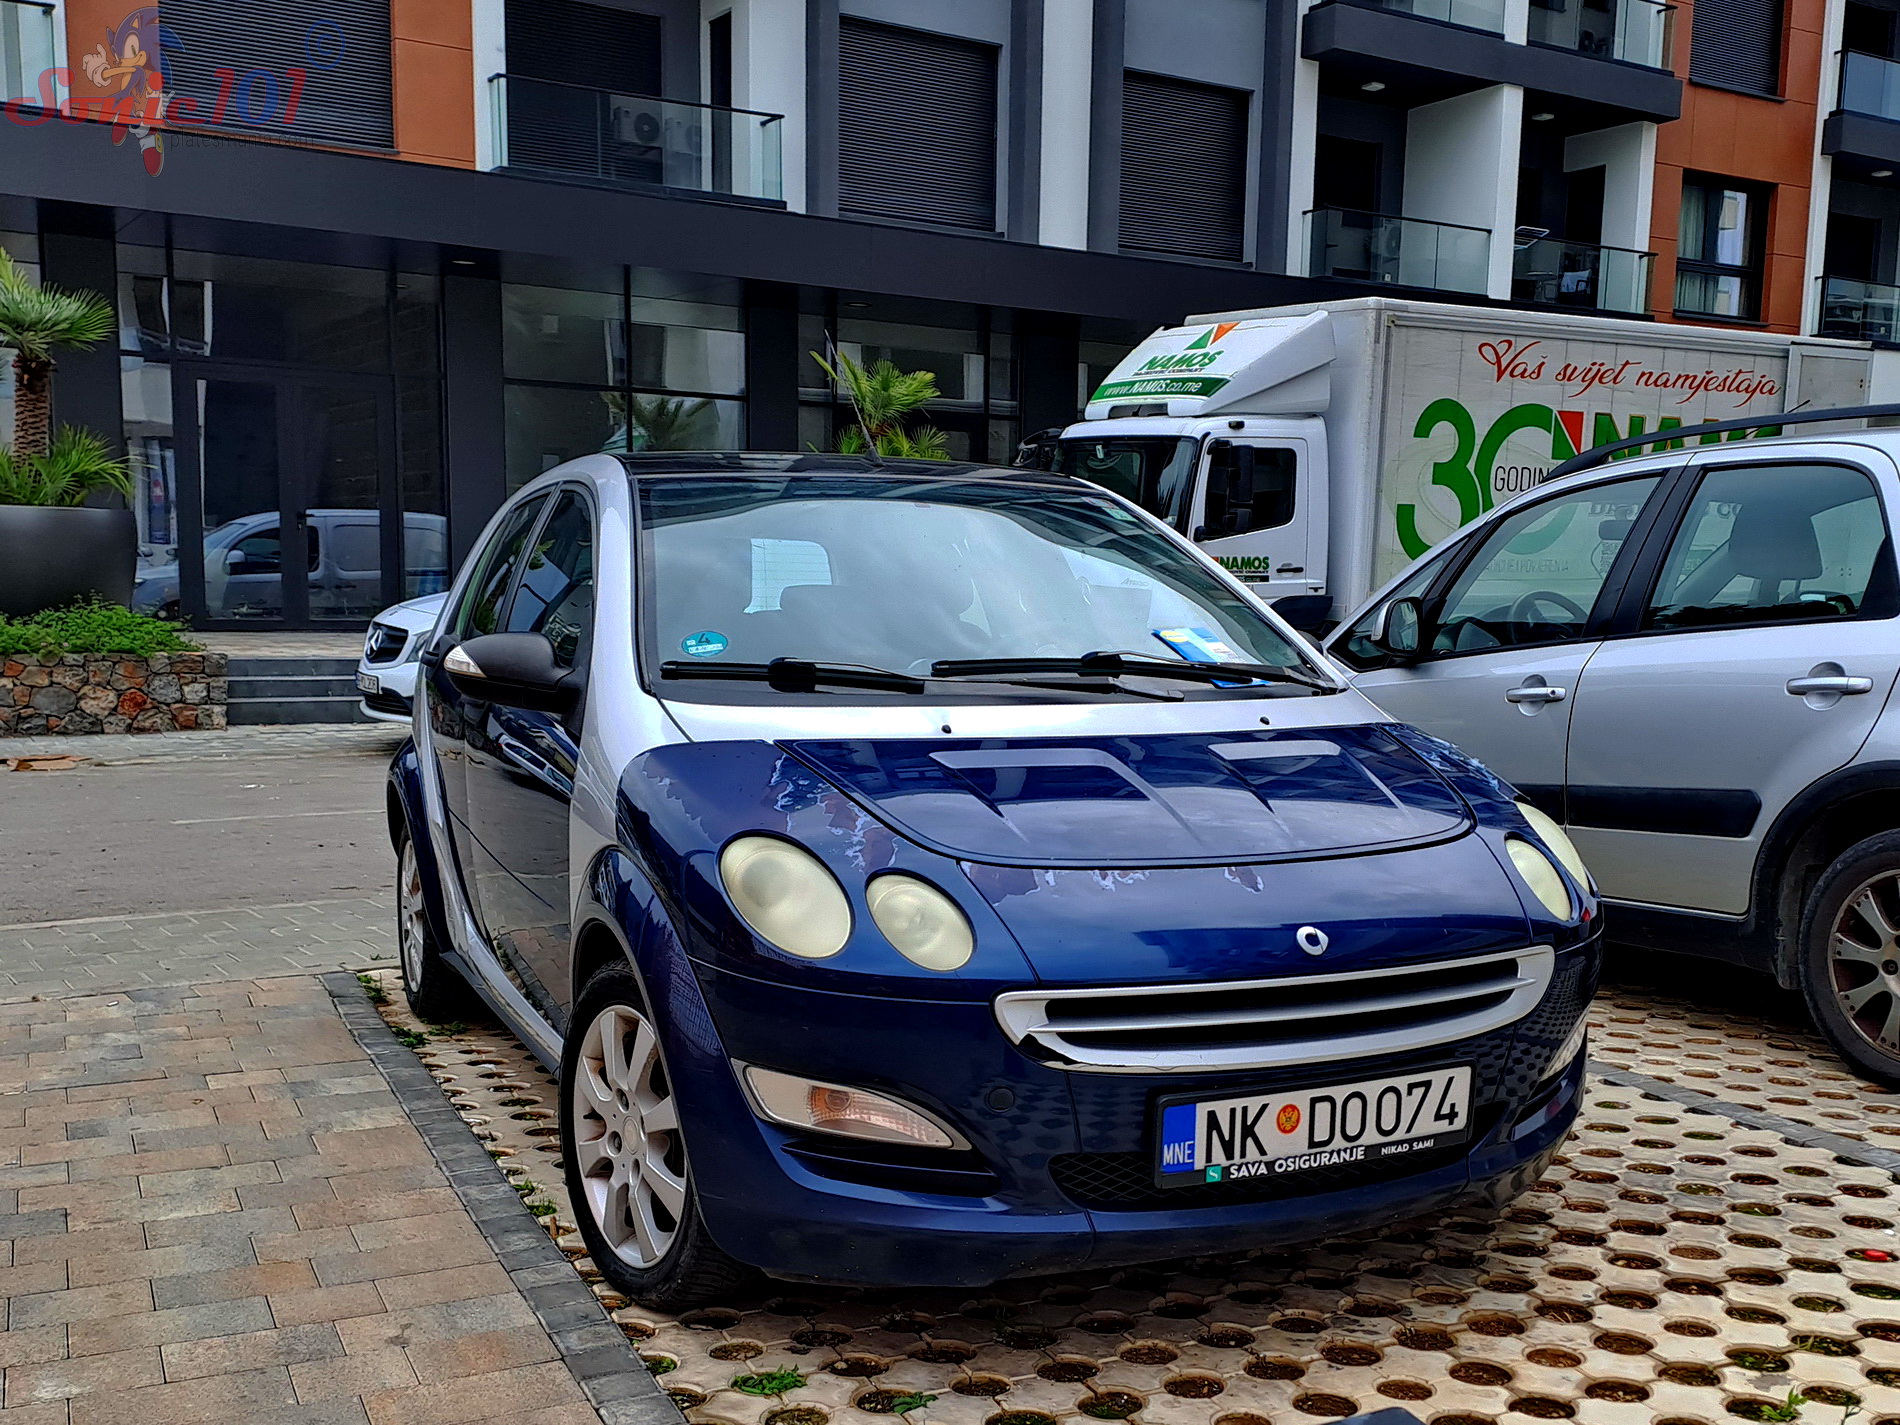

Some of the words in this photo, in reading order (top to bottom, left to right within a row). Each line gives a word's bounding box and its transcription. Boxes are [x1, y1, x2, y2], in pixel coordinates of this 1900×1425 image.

[1137, 350, 1225, 371] NAMOS
[1478, 339, 1548, 383] Vaš
[1555, 360, 1643, 398] svijet
[1635, 369, 1783, 408] namještaja
[1104, 380, 1203, 396] www.NAMOS.co.me
[1219, 556, 1270, 570] NAMOS
[1163, 1140, 1194, 1167] MNE
[1205, 1103, 1270, 1164] NK
[1229, 1159, 1268, 1179] SAVA
[1274, 1146, 1365, 1173] OSIGURANJE
[1381, 1142, 1409, 1156] NIKAD
[1412, 1138, 1434, 1151] SAMI
